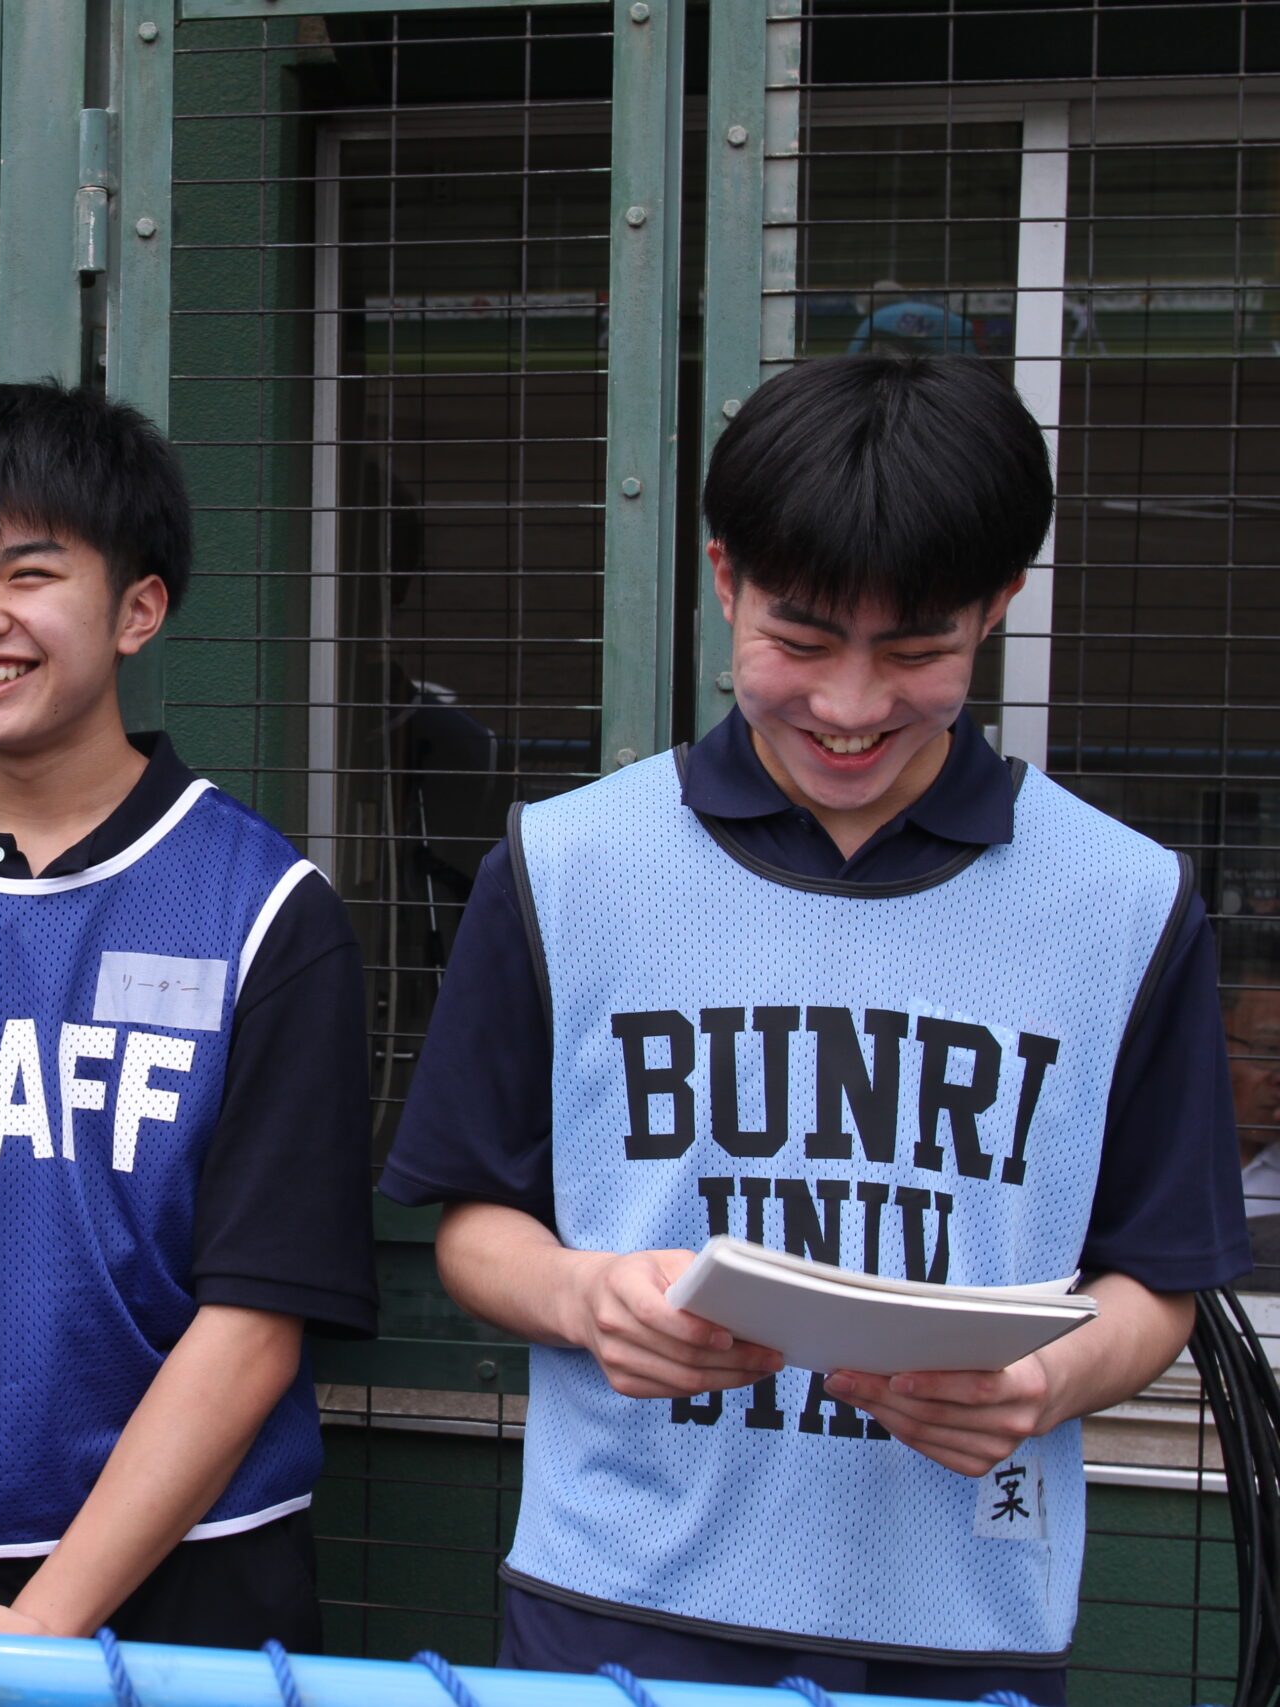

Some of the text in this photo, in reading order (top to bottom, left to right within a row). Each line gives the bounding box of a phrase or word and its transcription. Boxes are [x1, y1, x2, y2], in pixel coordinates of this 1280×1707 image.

[122, 973, 200, 992] リーダー
[611, 1006, 1061, 1186] BUNRI
[991, 1462, 1046, 1522] 案
